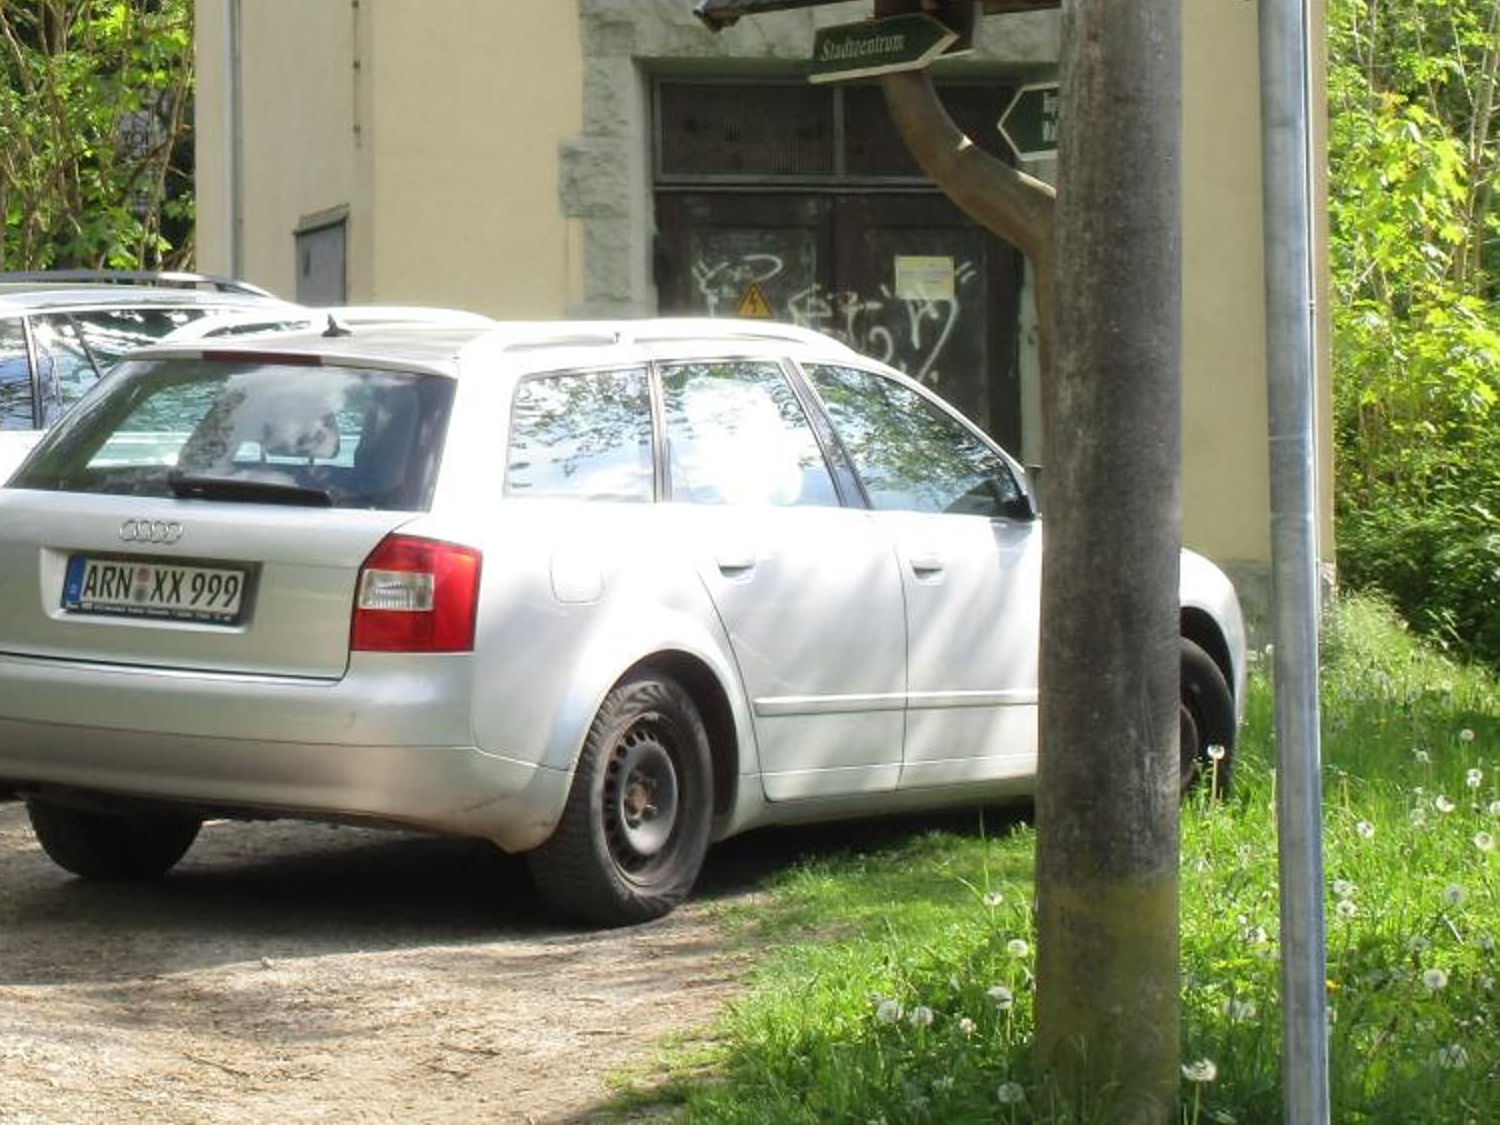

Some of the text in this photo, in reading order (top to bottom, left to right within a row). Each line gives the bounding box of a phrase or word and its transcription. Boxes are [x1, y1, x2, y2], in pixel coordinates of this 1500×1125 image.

[82, 564, 240, 608] ARN XX 999
